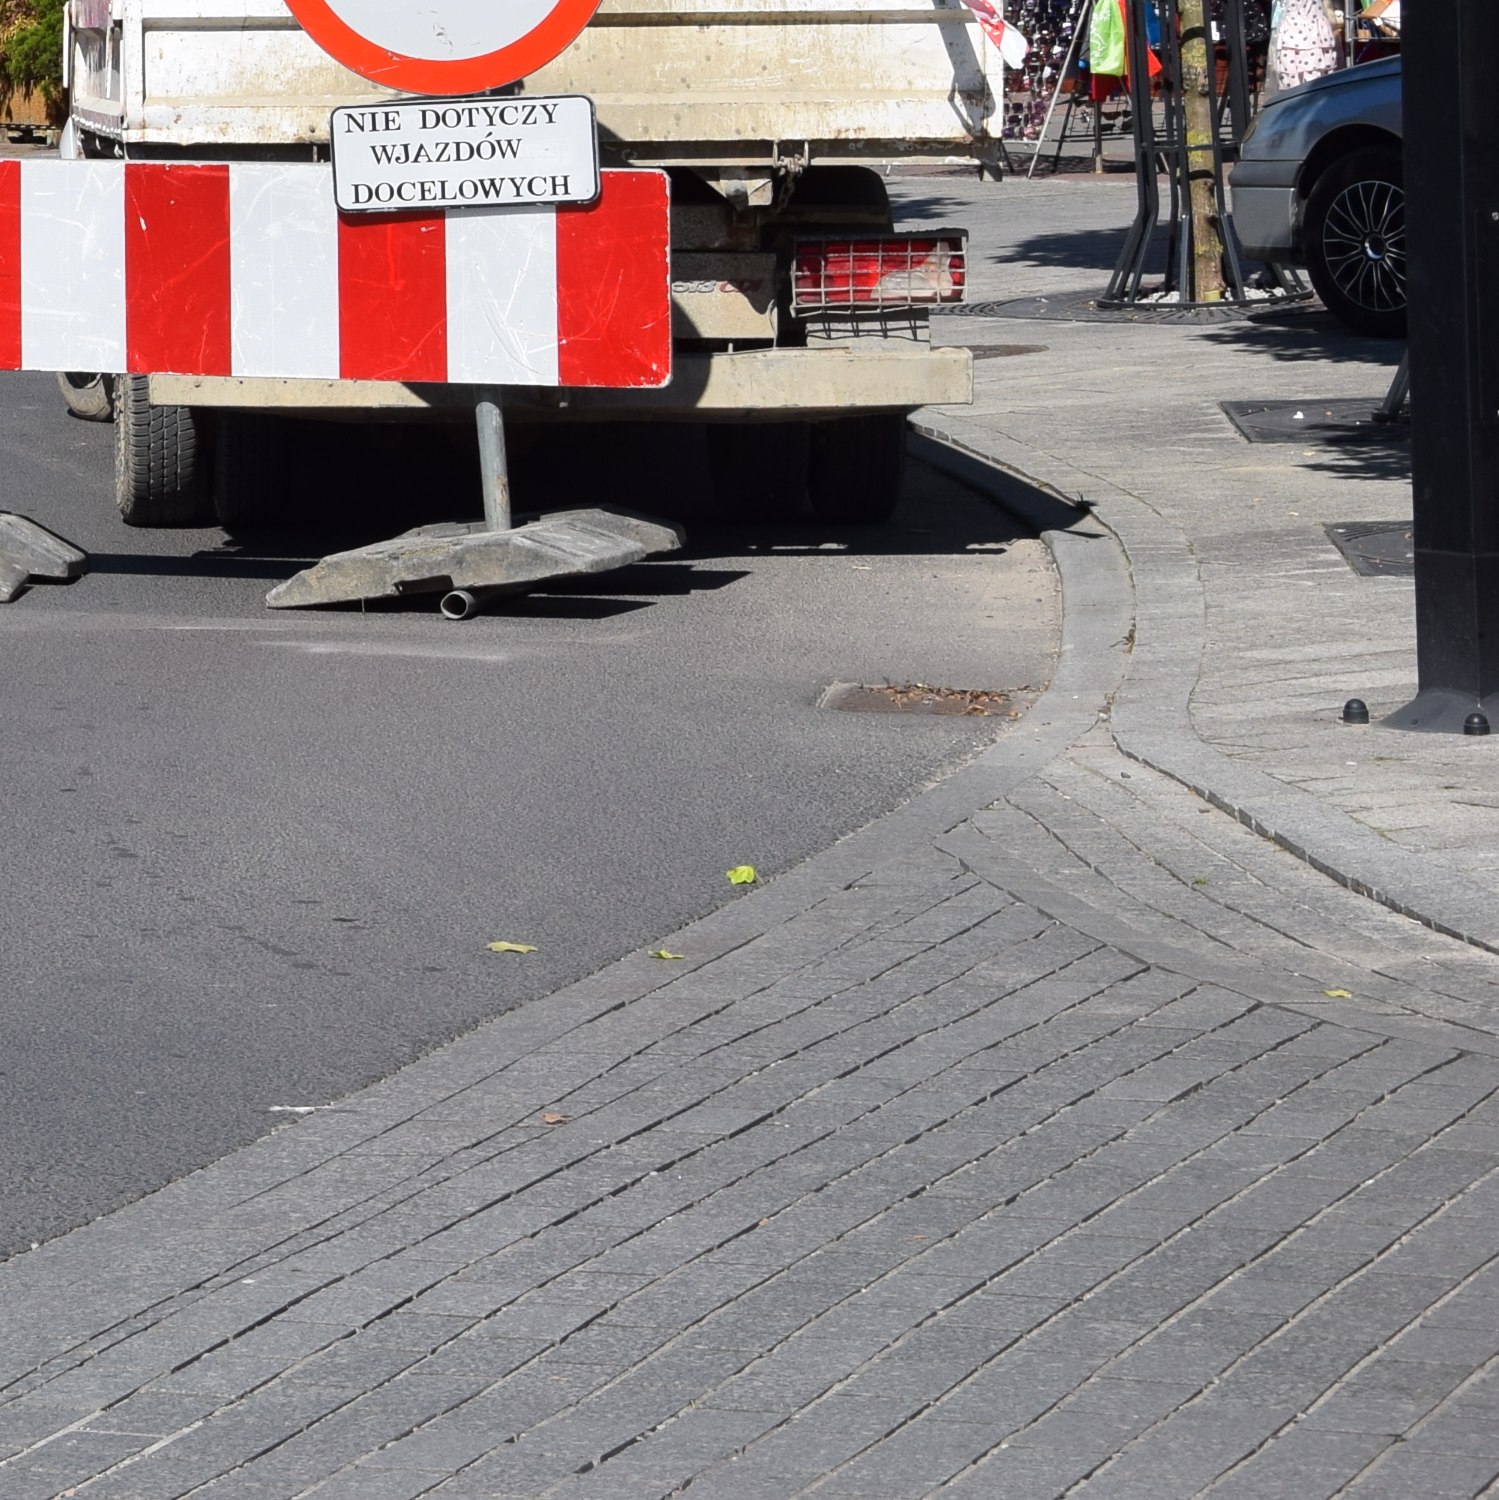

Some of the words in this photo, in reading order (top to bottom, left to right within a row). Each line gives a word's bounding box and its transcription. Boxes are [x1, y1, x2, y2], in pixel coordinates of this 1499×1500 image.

[344, 110, 401, 133] NIE
[419, 103, 559, 130] DOTYCZY
[370, 131, 523, 165] WJAZDÓW
[351, 174, 572, 204] DOCELOWYCH
